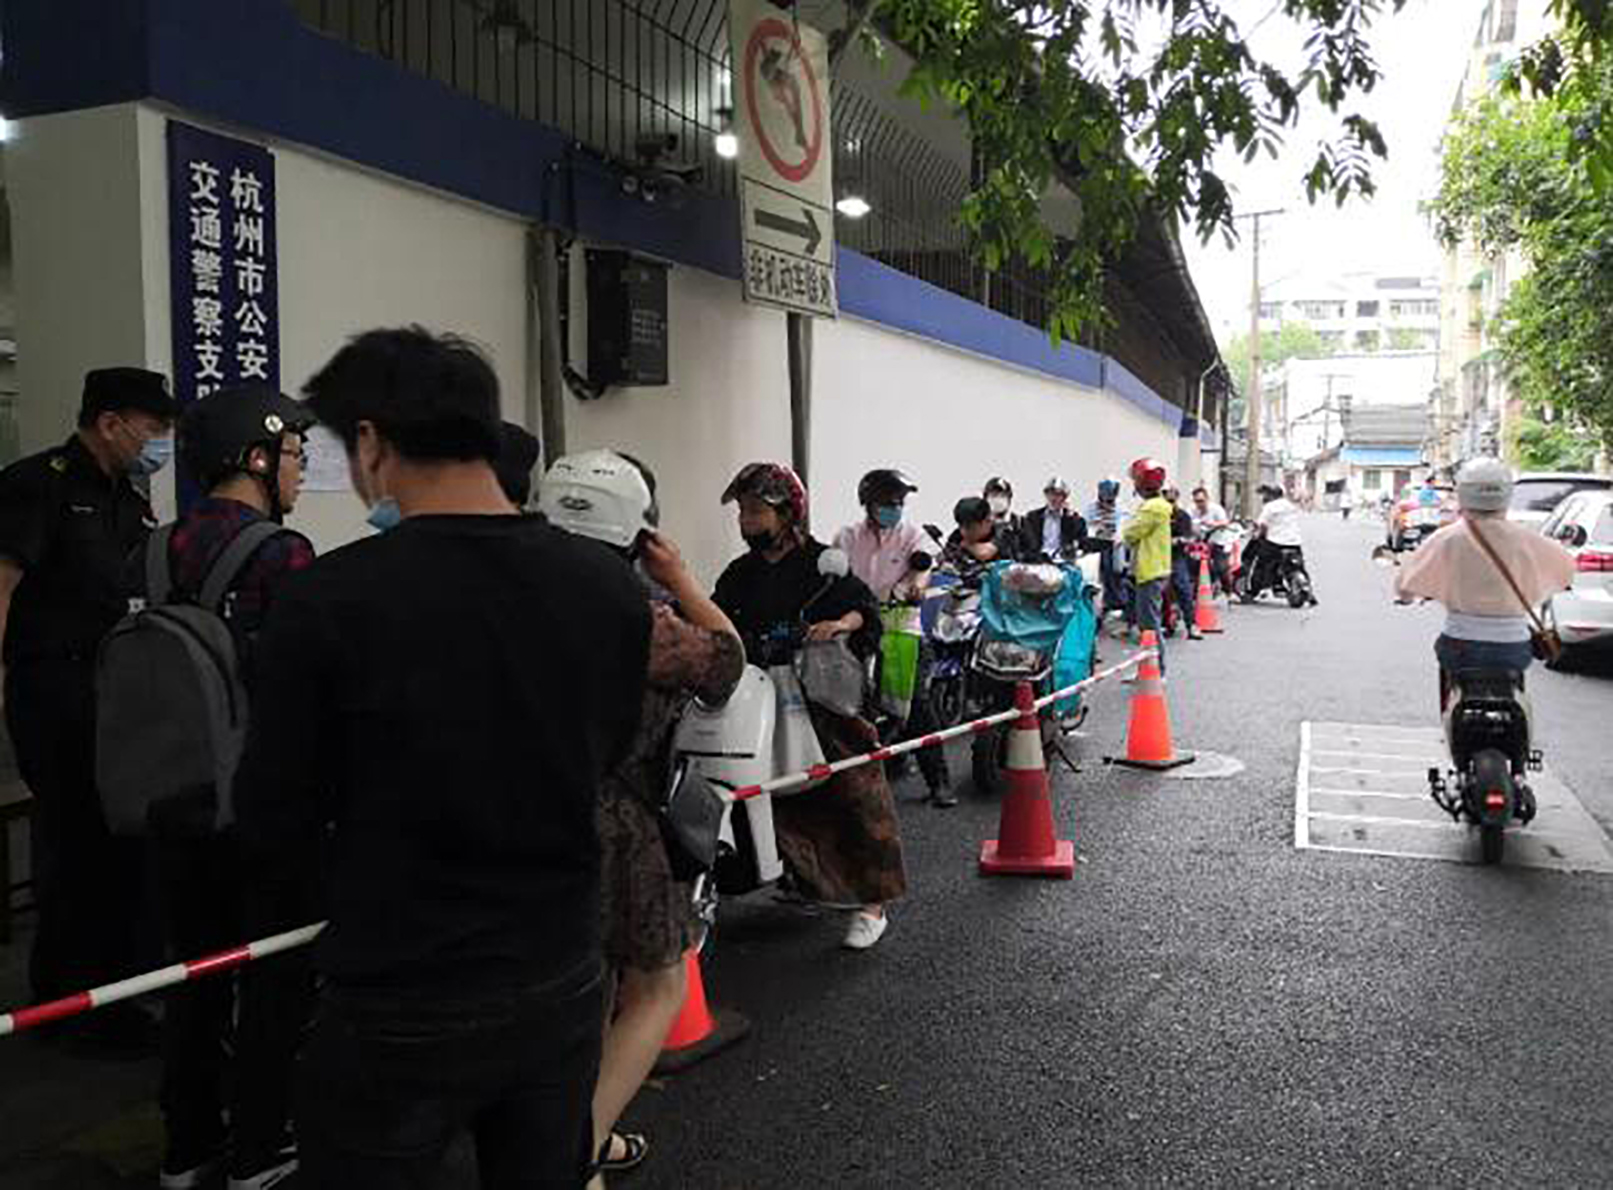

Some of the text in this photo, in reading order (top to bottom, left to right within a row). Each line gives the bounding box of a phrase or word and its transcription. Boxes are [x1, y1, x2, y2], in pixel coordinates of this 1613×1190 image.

[229, 166, 269, 380] 杭州市公安
